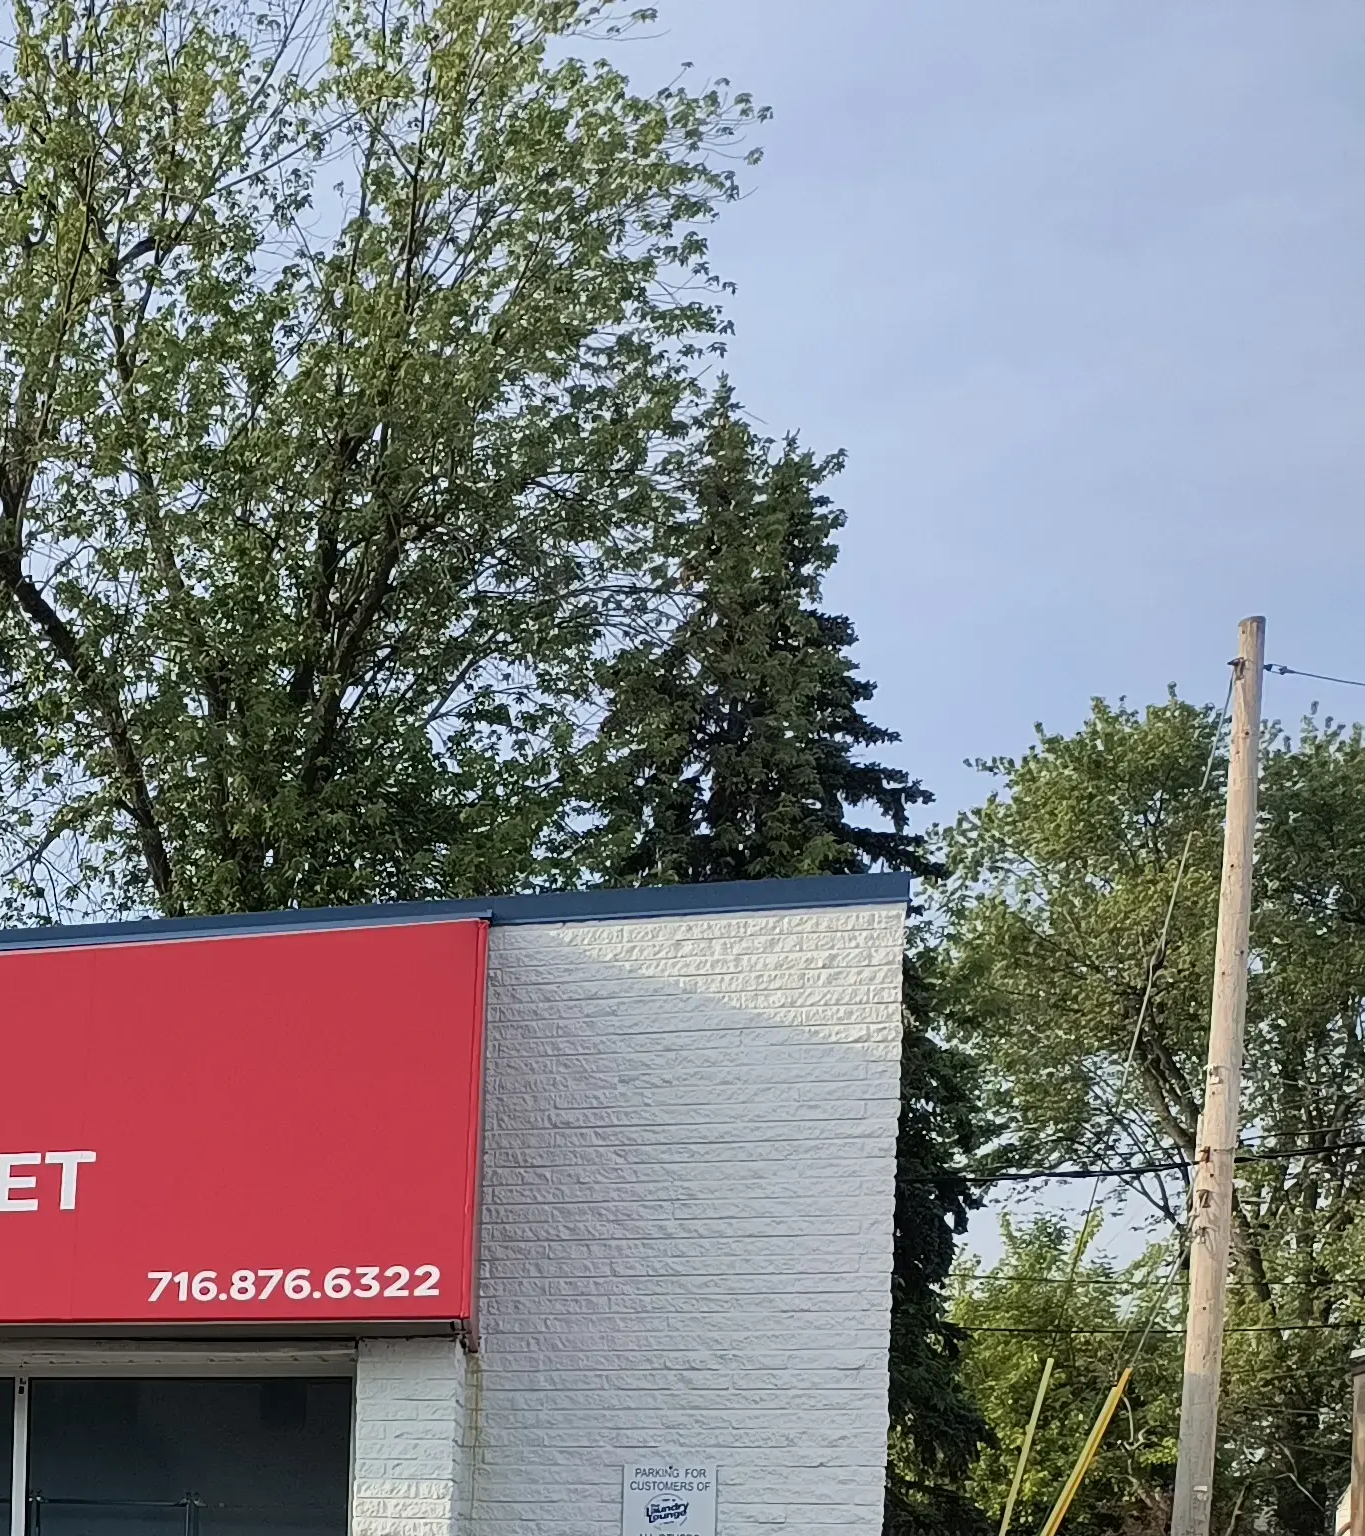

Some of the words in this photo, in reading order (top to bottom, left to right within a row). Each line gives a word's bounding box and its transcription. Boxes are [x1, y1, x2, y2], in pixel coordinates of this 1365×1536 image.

[146, 1264, 440, 1302] 716.876.6322
[635, 1467, 680, 1478] PARKING
[685, 1468, 707, 1478] FOR
[629, 1481, 694, 1491] CUSTOMERS
[697, 1481, 711, 1491] OF
[646, 1501, 689, 1517] Laundry
